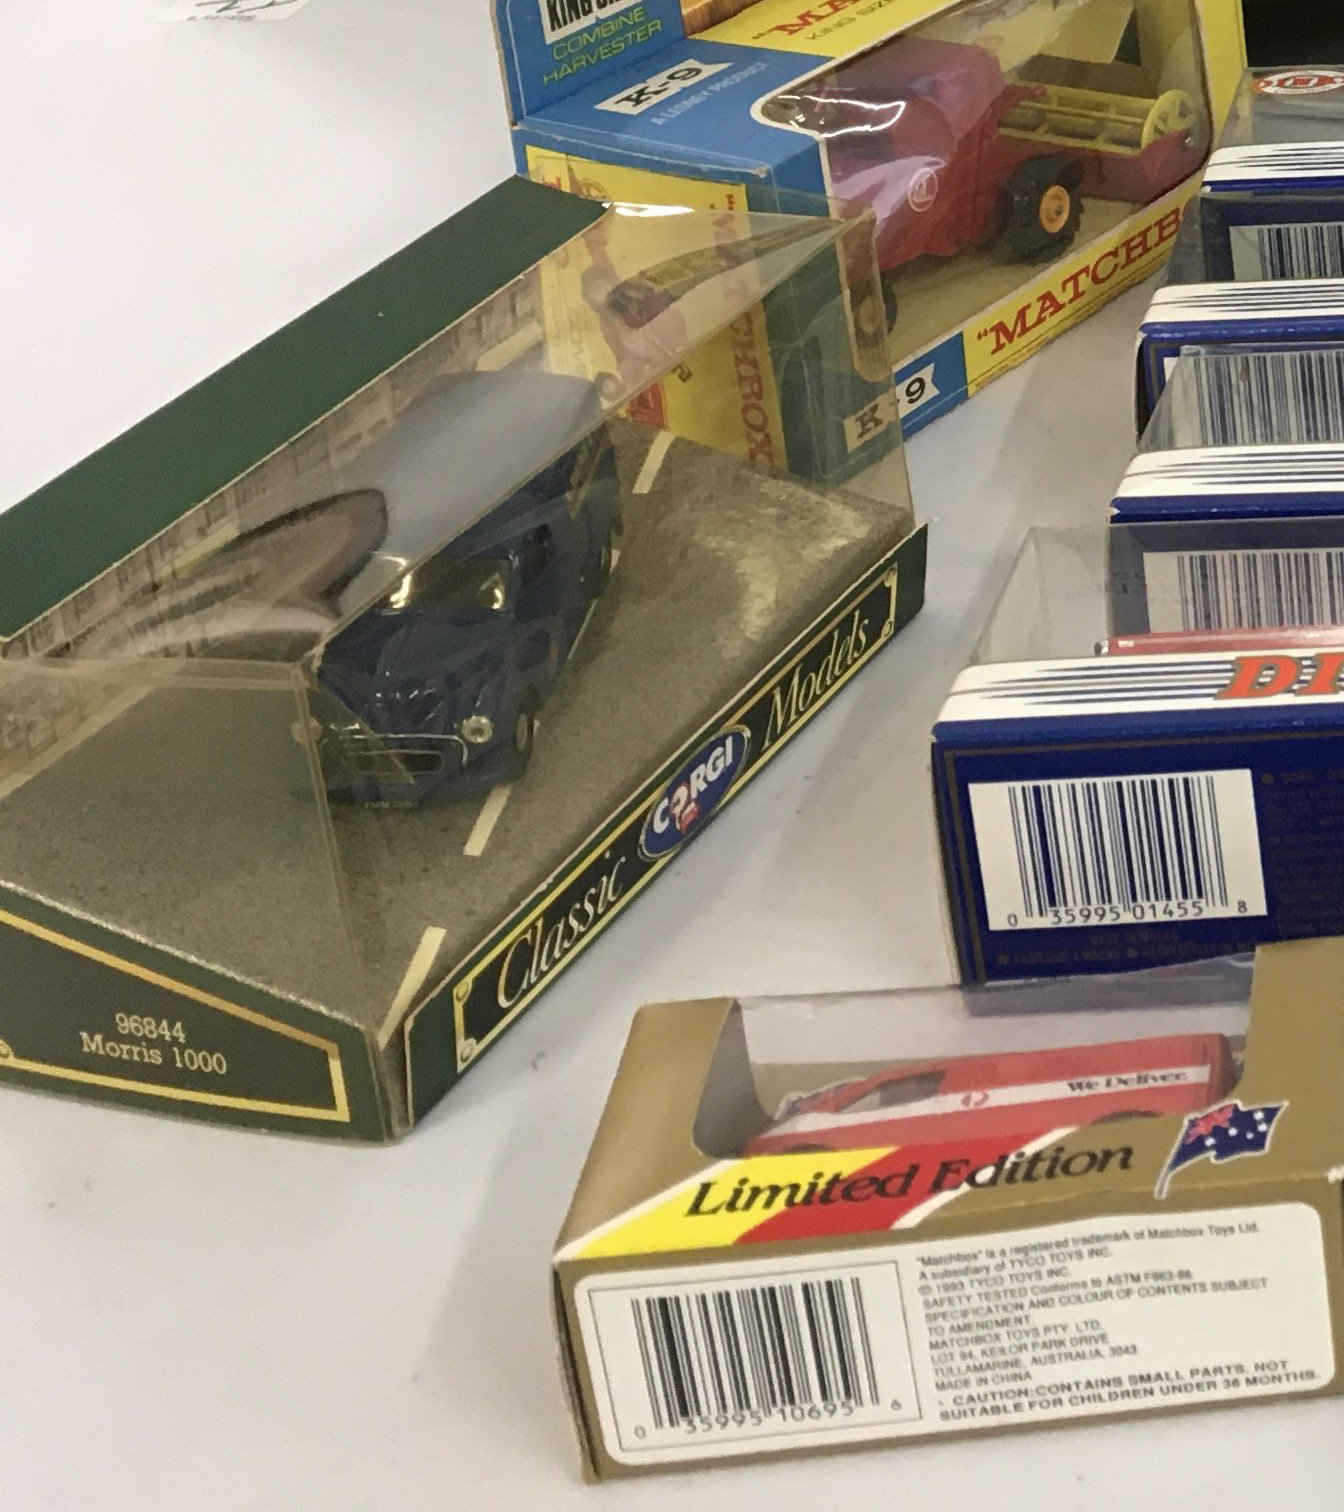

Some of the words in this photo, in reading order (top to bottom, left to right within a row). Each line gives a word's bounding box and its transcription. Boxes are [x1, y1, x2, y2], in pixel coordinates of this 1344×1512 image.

[543, 19, 662, 85] HARVESTER
[553, 7, 646, 60] COMBINE
[615, 67, 702, 107] K-9
[498, 852, 625, 1008] Classic
[762, 612, 869, 750] Models
[1007, 914, 1018, 927] 0
[1050, 906, 1121, 925] 35995
[1132, 901, 1203, 920] 01455
[1238, 901, 1248, 914] 8
[115, 1013, 186, 1044] 96844
[80, 1032, 162, 1066] Morris
[173, 1047, 226, 1075] 1000
[684, 1164, 919, 1217] Limited
[929, 1146, 1134, 1192] Edition
[1128, 1370, 1184, 1385] SMALL
[1254, 1360, 1288, 1372] NOT
[940, 1402, 1023, 1421] SUITABLE
[1028, 1397, 1063, 1410] FOR
[1068, 1387, 1154, 1406] CHILDREN
[1159, 1380, 1218, 1396] UNDER
